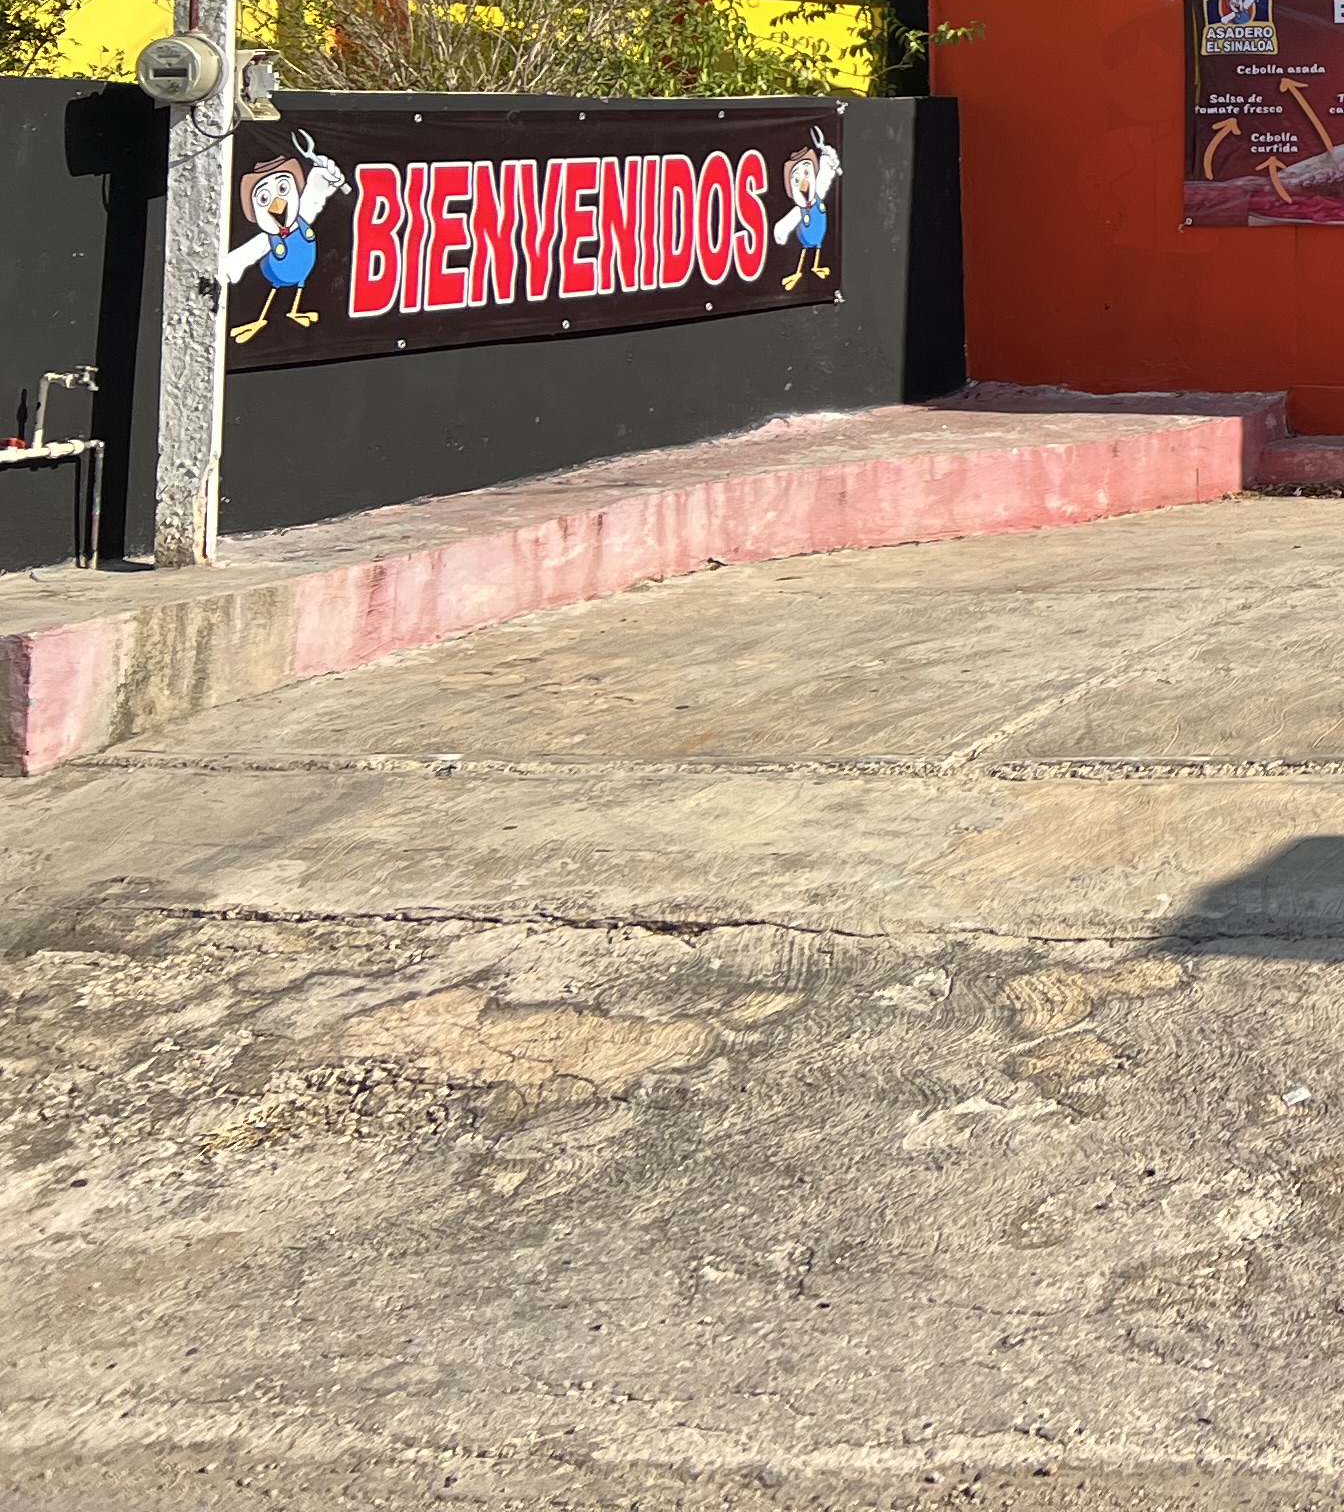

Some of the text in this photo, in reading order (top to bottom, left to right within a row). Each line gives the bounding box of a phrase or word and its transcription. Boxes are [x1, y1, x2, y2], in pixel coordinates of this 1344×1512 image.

[1206, 27, 1273, 39] ASADERO
[1207, 40, 1274, 53] EL SINALOA
[1237, 64, 1325, 75] Cebolla asada
[1209, 94, 1263, 104] Salsa de
[1195, 104, 1283, 115] tomate fresco
[1250, 133, 1298, 143] Cebolla
[1250, 143, 1298, 153] curtida
[349, 149, 768, 317] BIENVENIDOS
